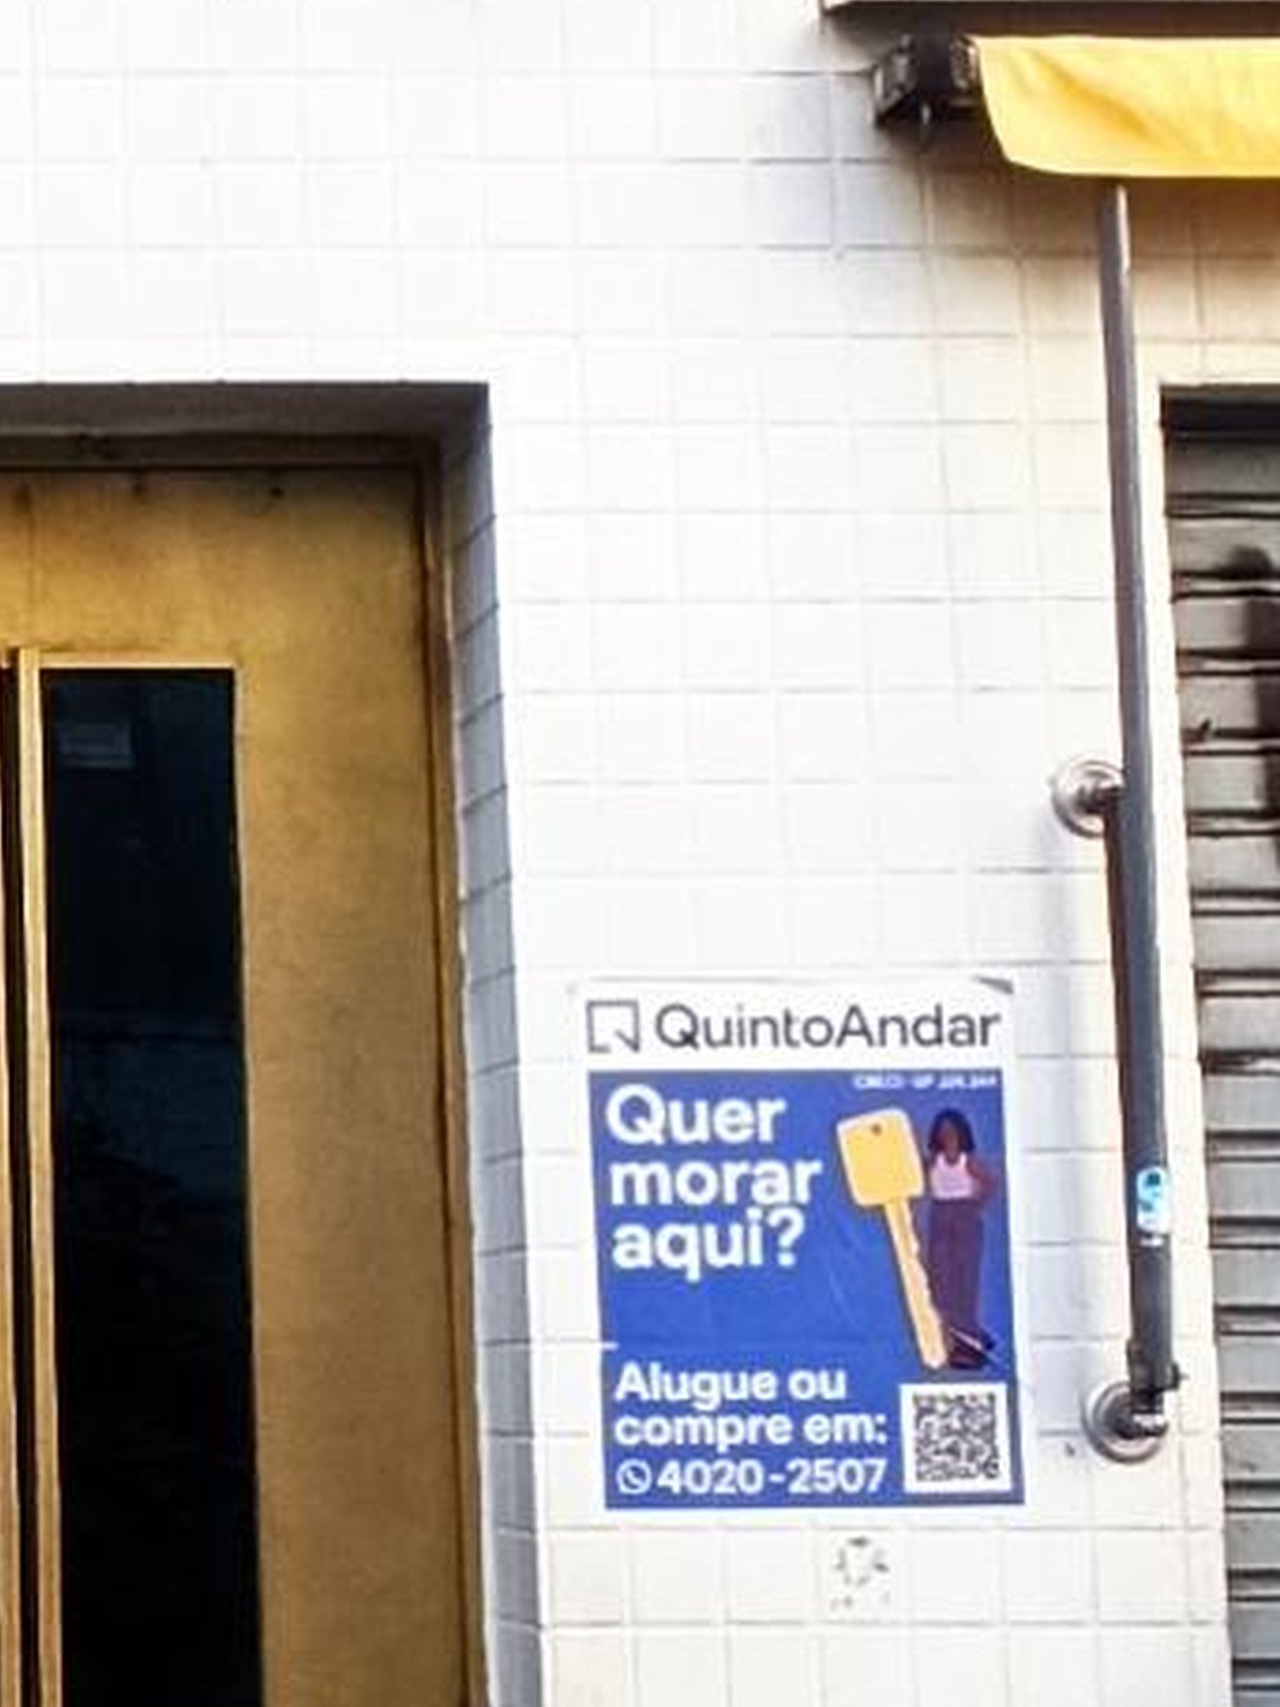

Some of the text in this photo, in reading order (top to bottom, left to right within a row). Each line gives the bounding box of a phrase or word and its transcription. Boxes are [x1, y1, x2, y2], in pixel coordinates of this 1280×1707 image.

[654, 1002, 1002, 1051] QuintoAndar
[605, 1083, 788, 1146] Quer
[609, 1157, 824, 1206] morar
[610, 1207, 806, 1283] aqui?
[614, 1361, 847, 1412] Alugue ou
[613, 1412, 888, 1454] compre em:
[656, 1457, 888, 1495] 4020-2507
